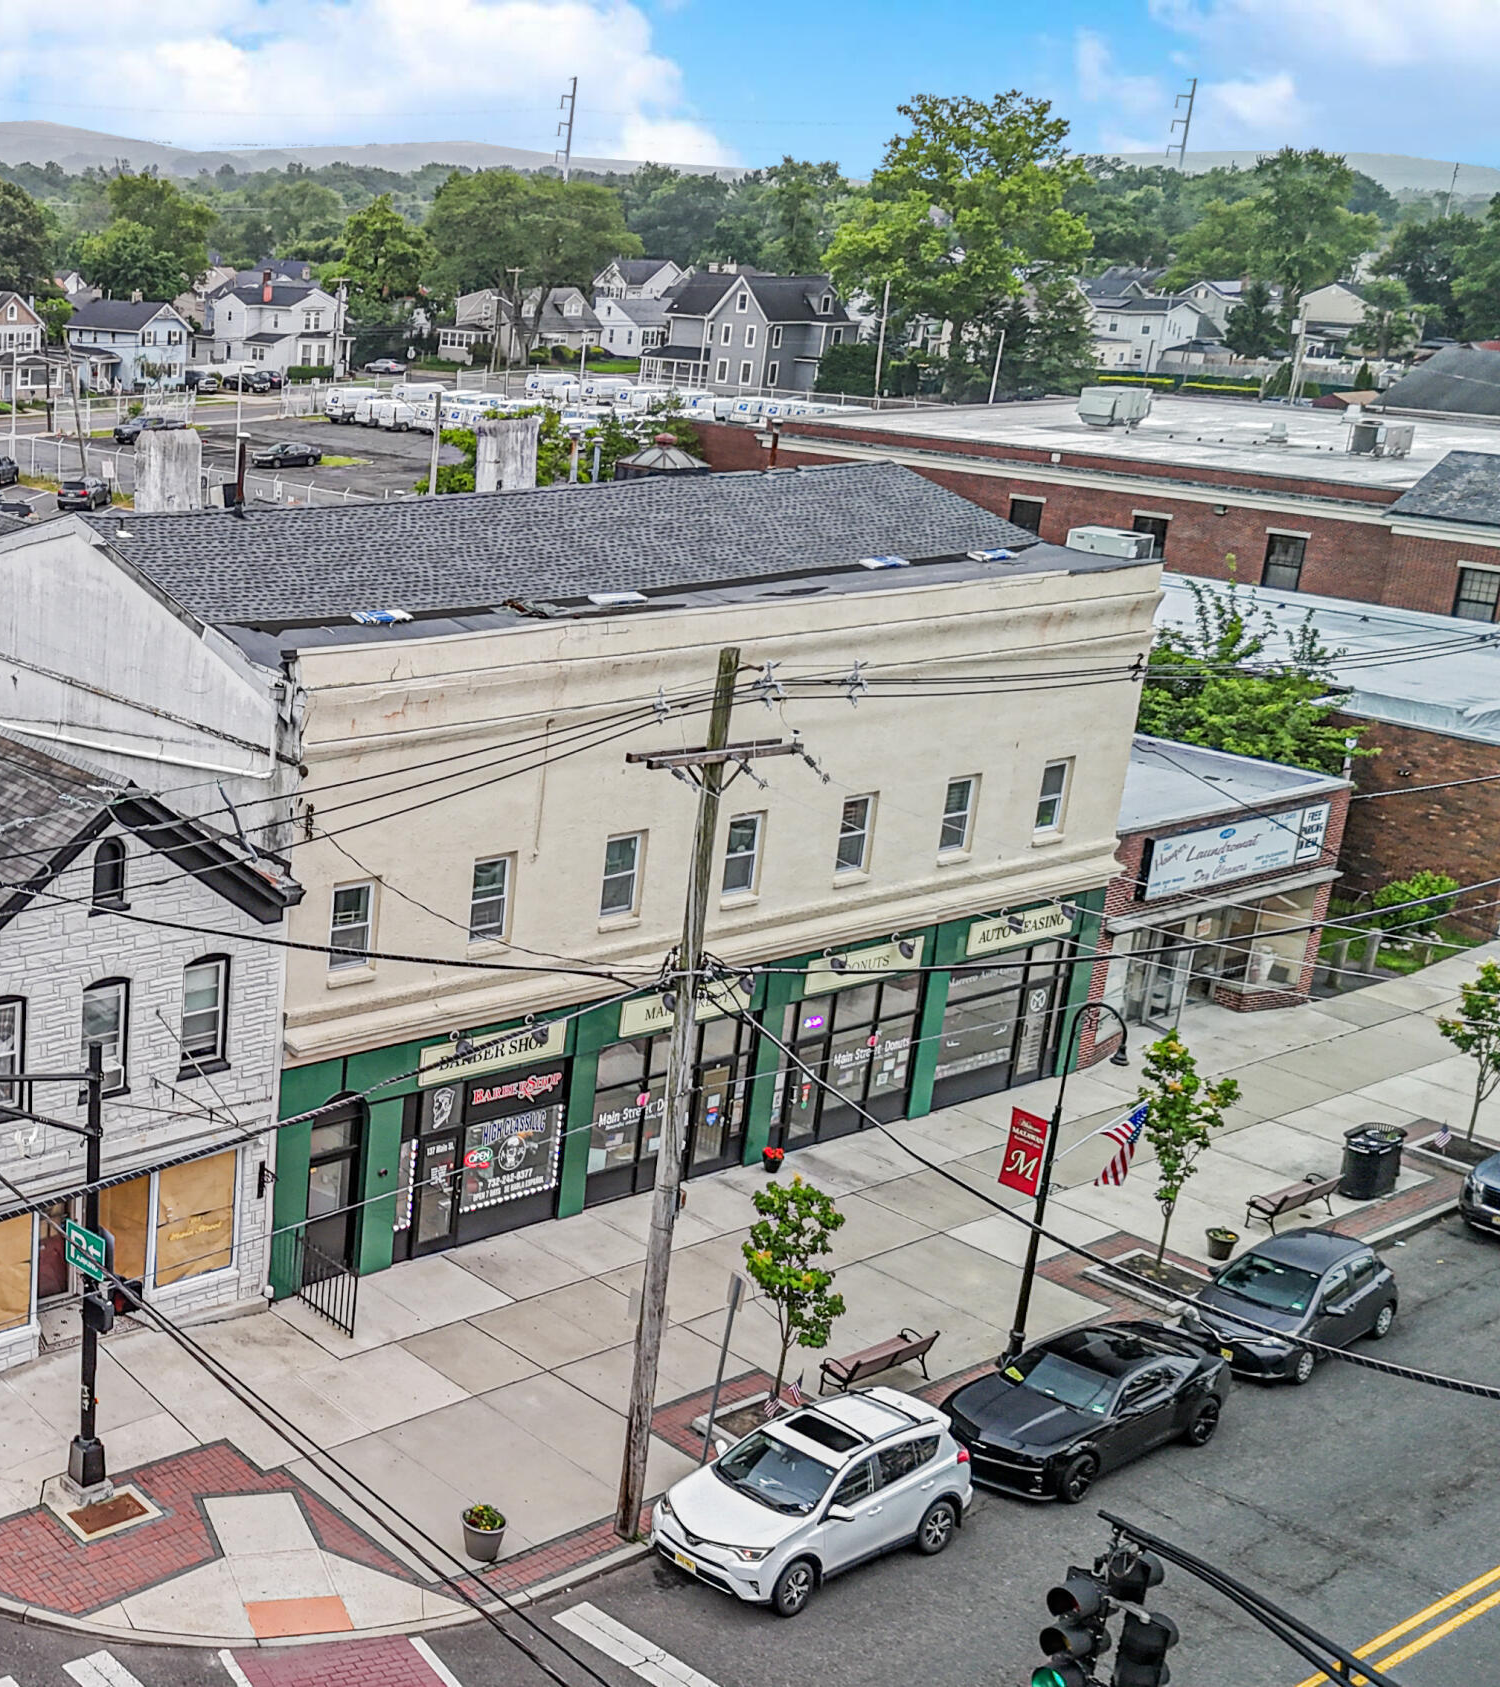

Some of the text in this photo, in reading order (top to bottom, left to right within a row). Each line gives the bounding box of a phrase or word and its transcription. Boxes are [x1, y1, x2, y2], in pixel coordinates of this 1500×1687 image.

[1186, 833, 1264, 862] Laundromat
[1193, 868, 1213, 883] Dry
[1211, 862, 1248, 881] Cleaners
[978, 913, 1064, 944] AUTO EASING
[508, 1035, 545, 1055] SHO
[833, 1050, 854, 1067] Main
[884, 1037, 911, 1053] Donuts
[482, 1109, 547, 1147] HIGH CLASS LLC
[598, 1110, 620, 1128] Main
[469, 1150, 490, 1163] OPEN
[1005, 1149, 1039, 1181] M
